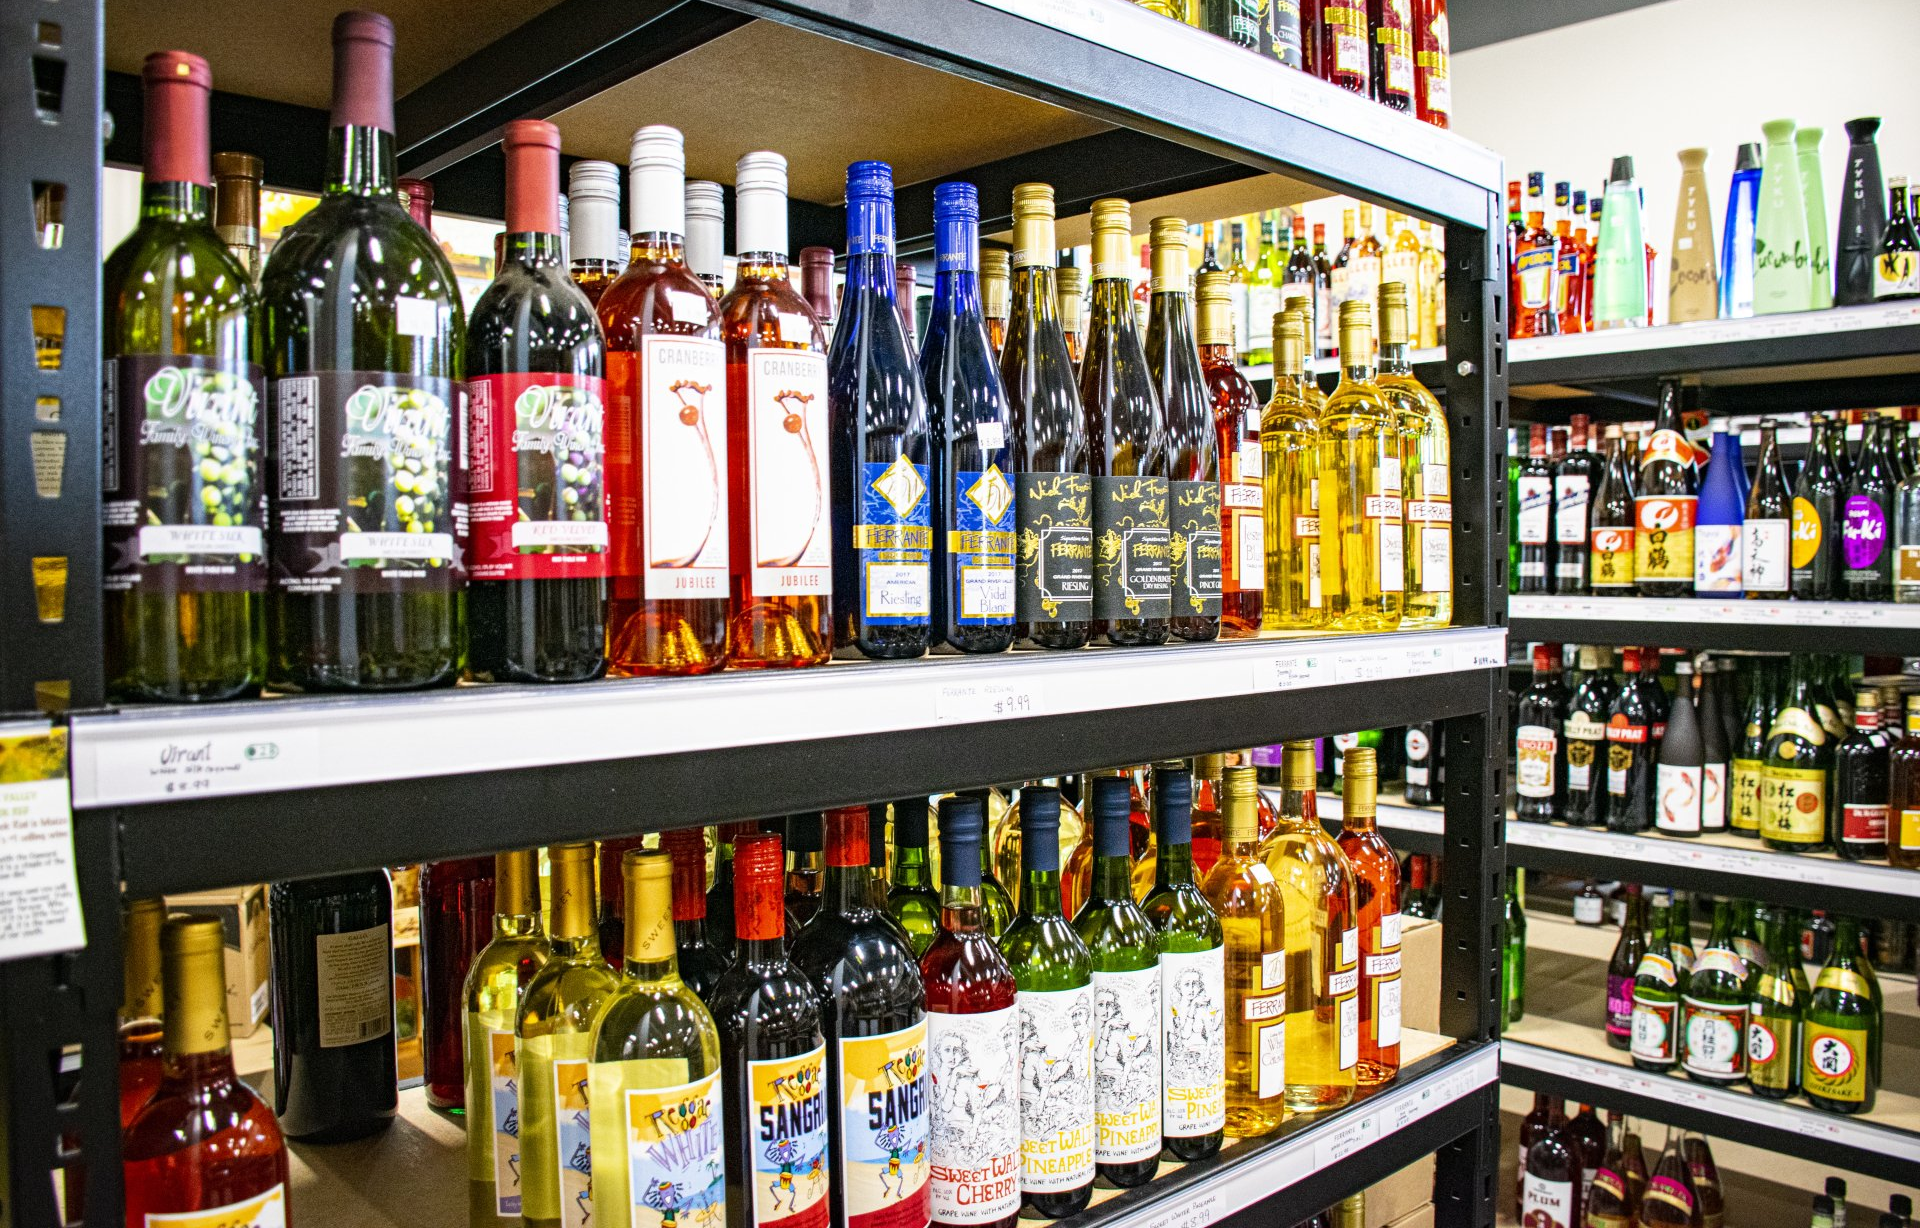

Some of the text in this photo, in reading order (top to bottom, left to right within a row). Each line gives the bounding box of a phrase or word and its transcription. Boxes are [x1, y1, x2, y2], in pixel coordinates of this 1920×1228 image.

[1853, 157, 1865, 200] TYKU
[1686, 185, 1698, 231] TYKU
[139, 420, 186, 448] Family
[511, 430, 549, 454] Family
[340, 433, 385, 461] Family
[170, 530, 214, 542] WHITE
[533, 523, 558, 535] RED
[866, 527, 929, 547] FERRANTE
[367, 536, 407, 548] WHITE
[960, 533, 1015, 551] FERRANTE
[1050, 541, 1092, 560] FERRANTE
[675, 576, 716, 589] JUBILEE
[780, 574, 819, 587] JUBILEE
[1061, 581, 1089, 592] RIESLING
[880, 589, 923, 607] Riesling
[980, 585, 1007, 600] Vidal
[980, 599, 1007, 613] Blanc
[1167, 1083, 1218, 1102] SWEET
[1095, 1112, 1138, 1127] SWEET
[1178, 1122, 1197, 1131] GRAPE
[646, 1120, 720, 1173] WHITE
[1112, 1149, 1128, 1157] WINE
[930, 1164, 991, 1183] SWEET
[1029, 1178, 1046, 1186] WINE
[1049, 1176, 1065, 1185] WITH
[956, 1173, 1017, 1206] CHERRY
[1527, 1189, 1561, 1208] PLUM
[937, 1207, 959, 1218] GRAPE
[960, 1210, 977, 1218] WINE
[980, 1207, 997, 1217] WITH
